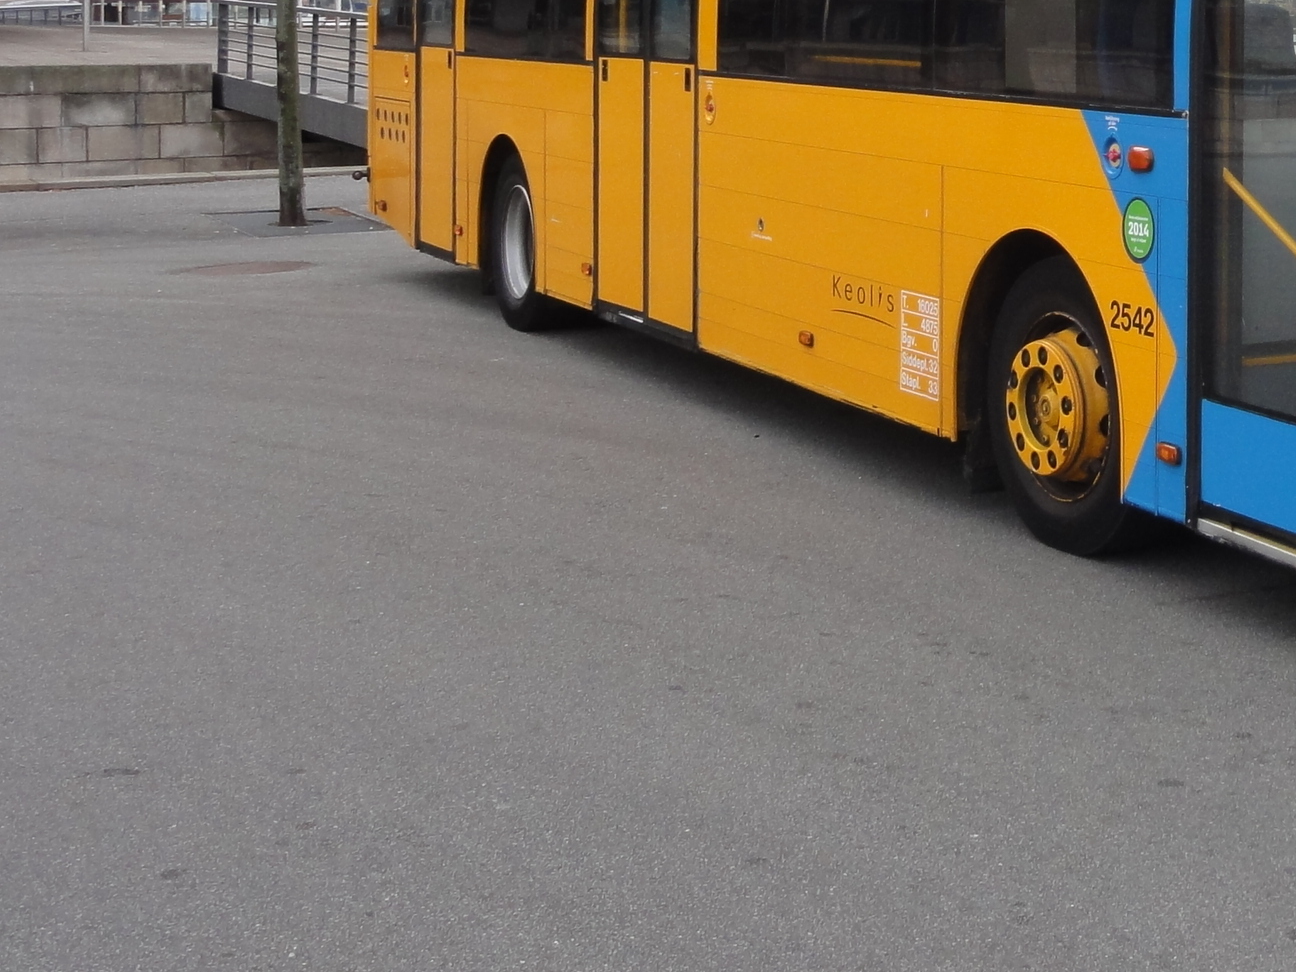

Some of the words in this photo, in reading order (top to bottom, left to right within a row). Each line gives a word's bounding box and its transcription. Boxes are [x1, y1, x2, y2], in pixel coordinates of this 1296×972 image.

[1128, 221, 1149, 237] 2014
[832, 274, 895, 313] Keolis
[918, 299, 938, 316] 16025
[921, 318, 938, 335] 4875
[1110, 300, 1154, 337] 2542
[933, 339, 938, 352] 0
[928, 359, 938, 374] 32
[928, 380, 938, 395] 33
